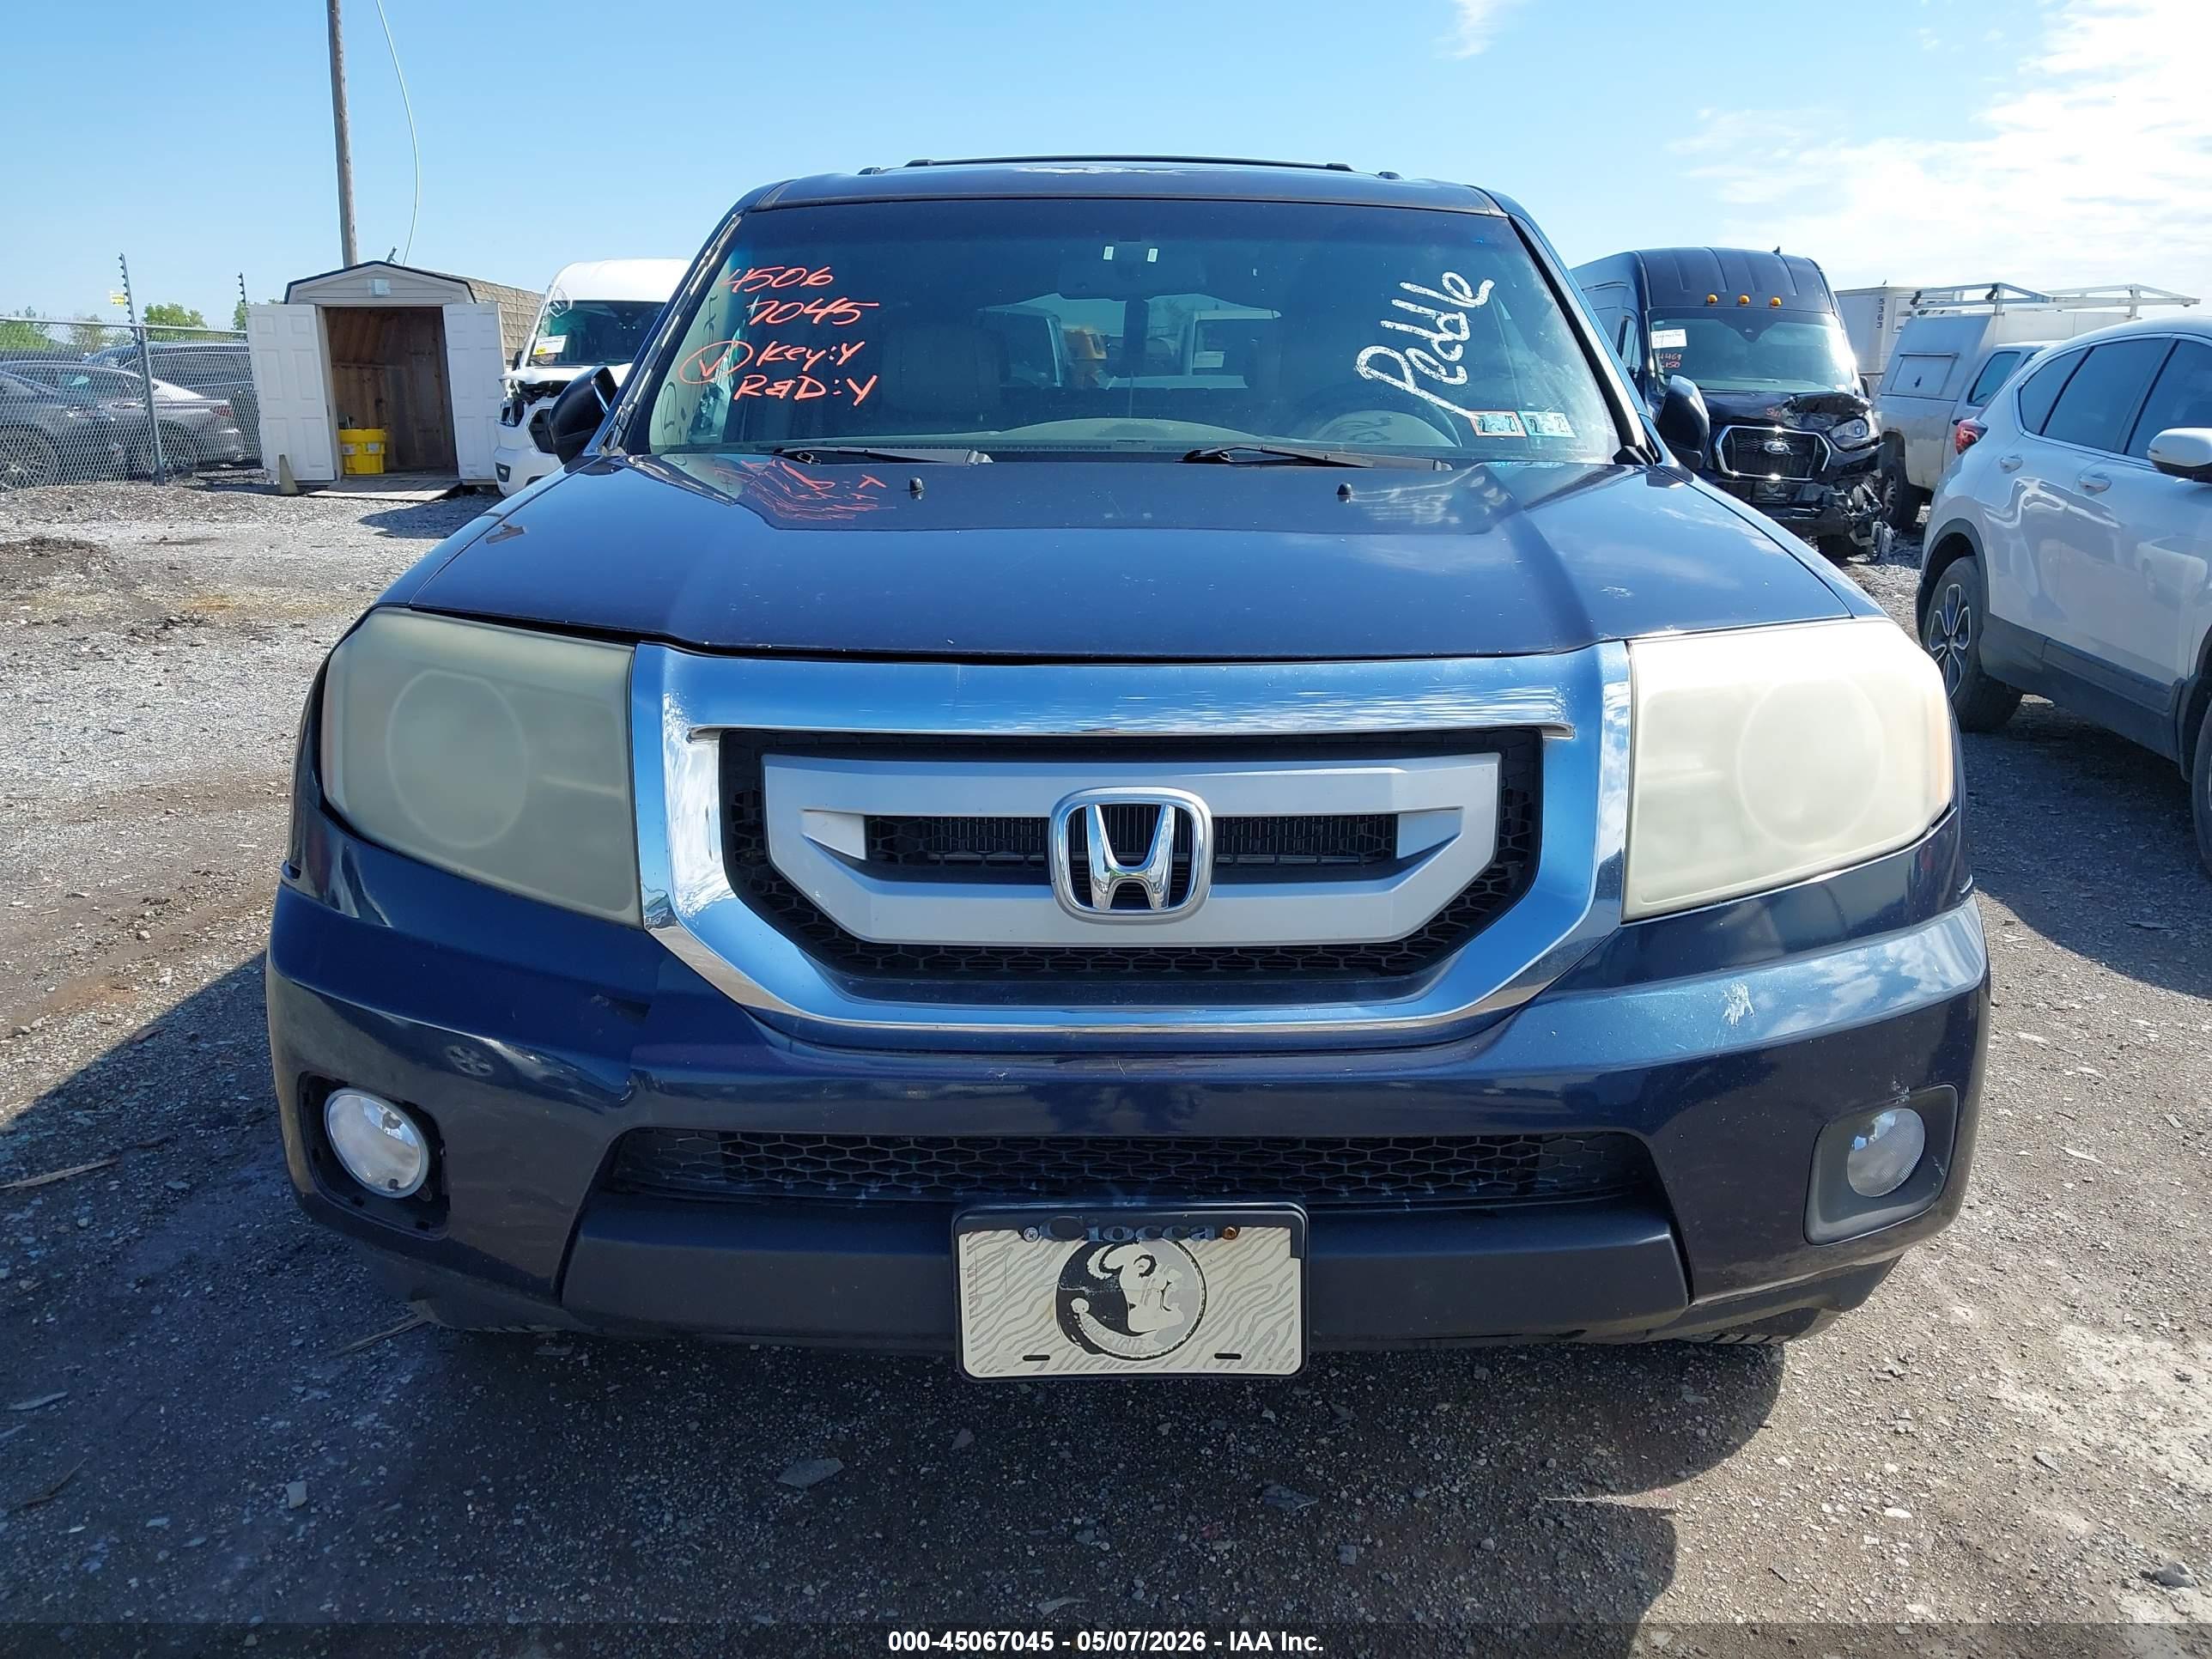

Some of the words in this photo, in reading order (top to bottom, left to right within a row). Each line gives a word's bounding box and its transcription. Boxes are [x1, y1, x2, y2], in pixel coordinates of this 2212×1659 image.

[721, 266, 834, 293] 4506
[746, 297, 879, 325] 7045
[1038, 1214, 1216, 1243] Ciocca
